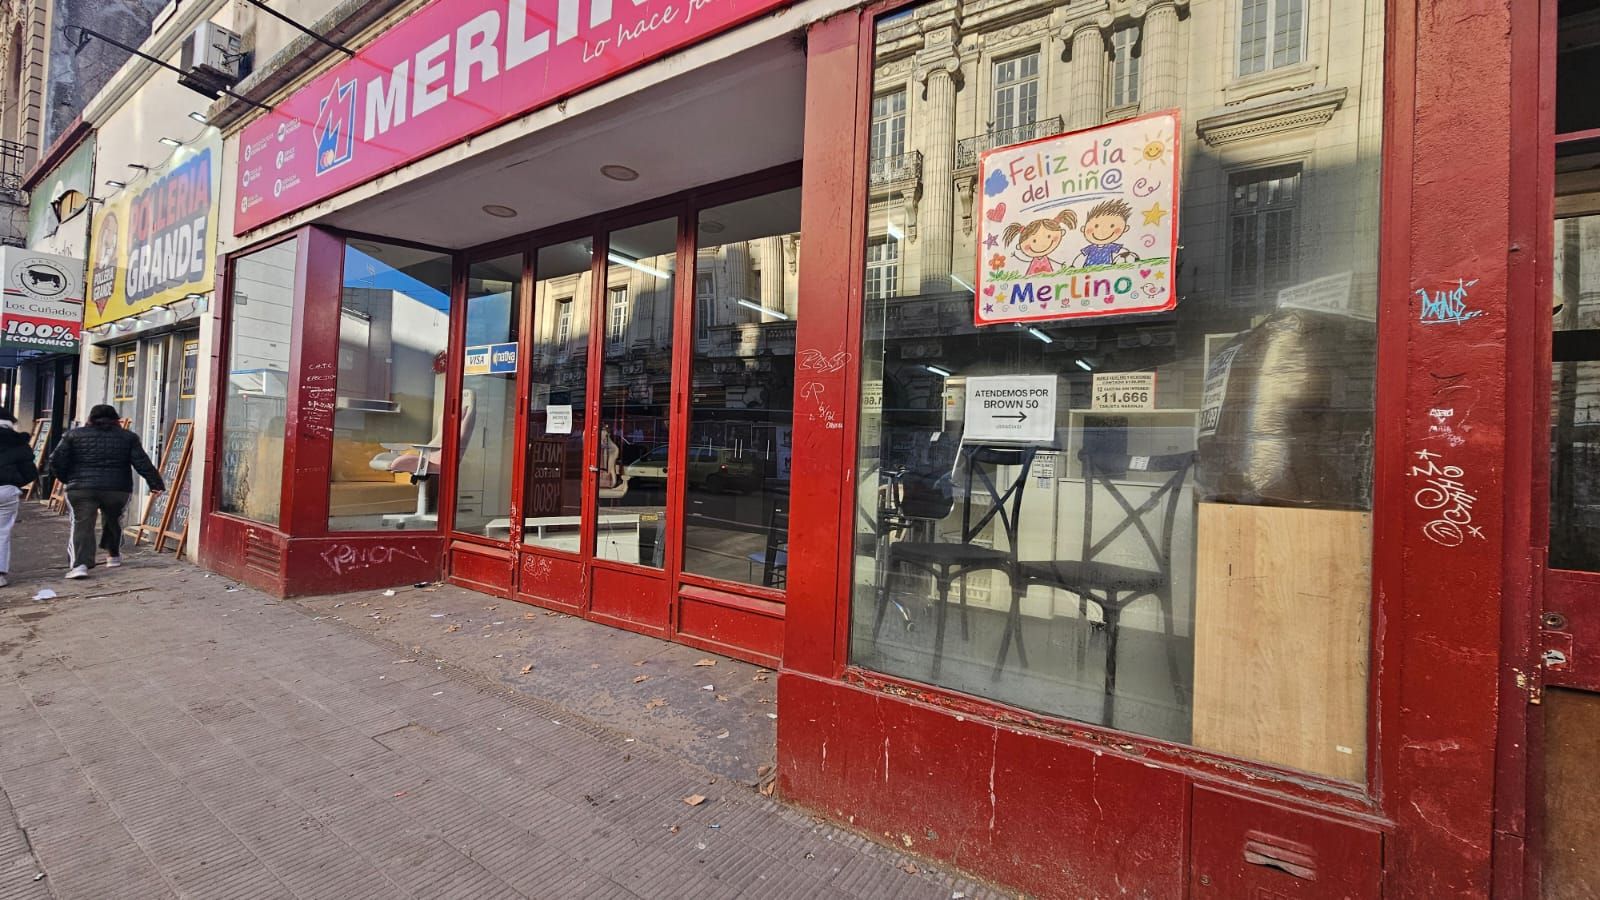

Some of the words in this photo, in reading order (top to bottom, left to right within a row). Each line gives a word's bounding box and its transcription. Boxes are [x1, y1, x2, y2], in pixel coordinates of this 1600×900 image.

[582, 38, 610, 63] Lo
[617, 8, 679, 47] hace
[1009, 153, 1069, 186] Feliz
[1022, 181, 1050, 204] del
[1061, 168, 1122, 195] niñ@
[128, 158, 210, 250] POLLERIA
[126, 215, 206, 298] GRANDE
[6, 300, 25, 311] Los
[29, 303, 77, 317] Cuñados
[7, 320, 74, 341] 100%
[469, 355, 485, 365] VISA
[975, 389, 1028, 398] ATENDEMOS
[1029, 388, 1049, 397] POR
[983, 399, 1024, 409] BROWN
[1025, 399, 1039, 409] 50
